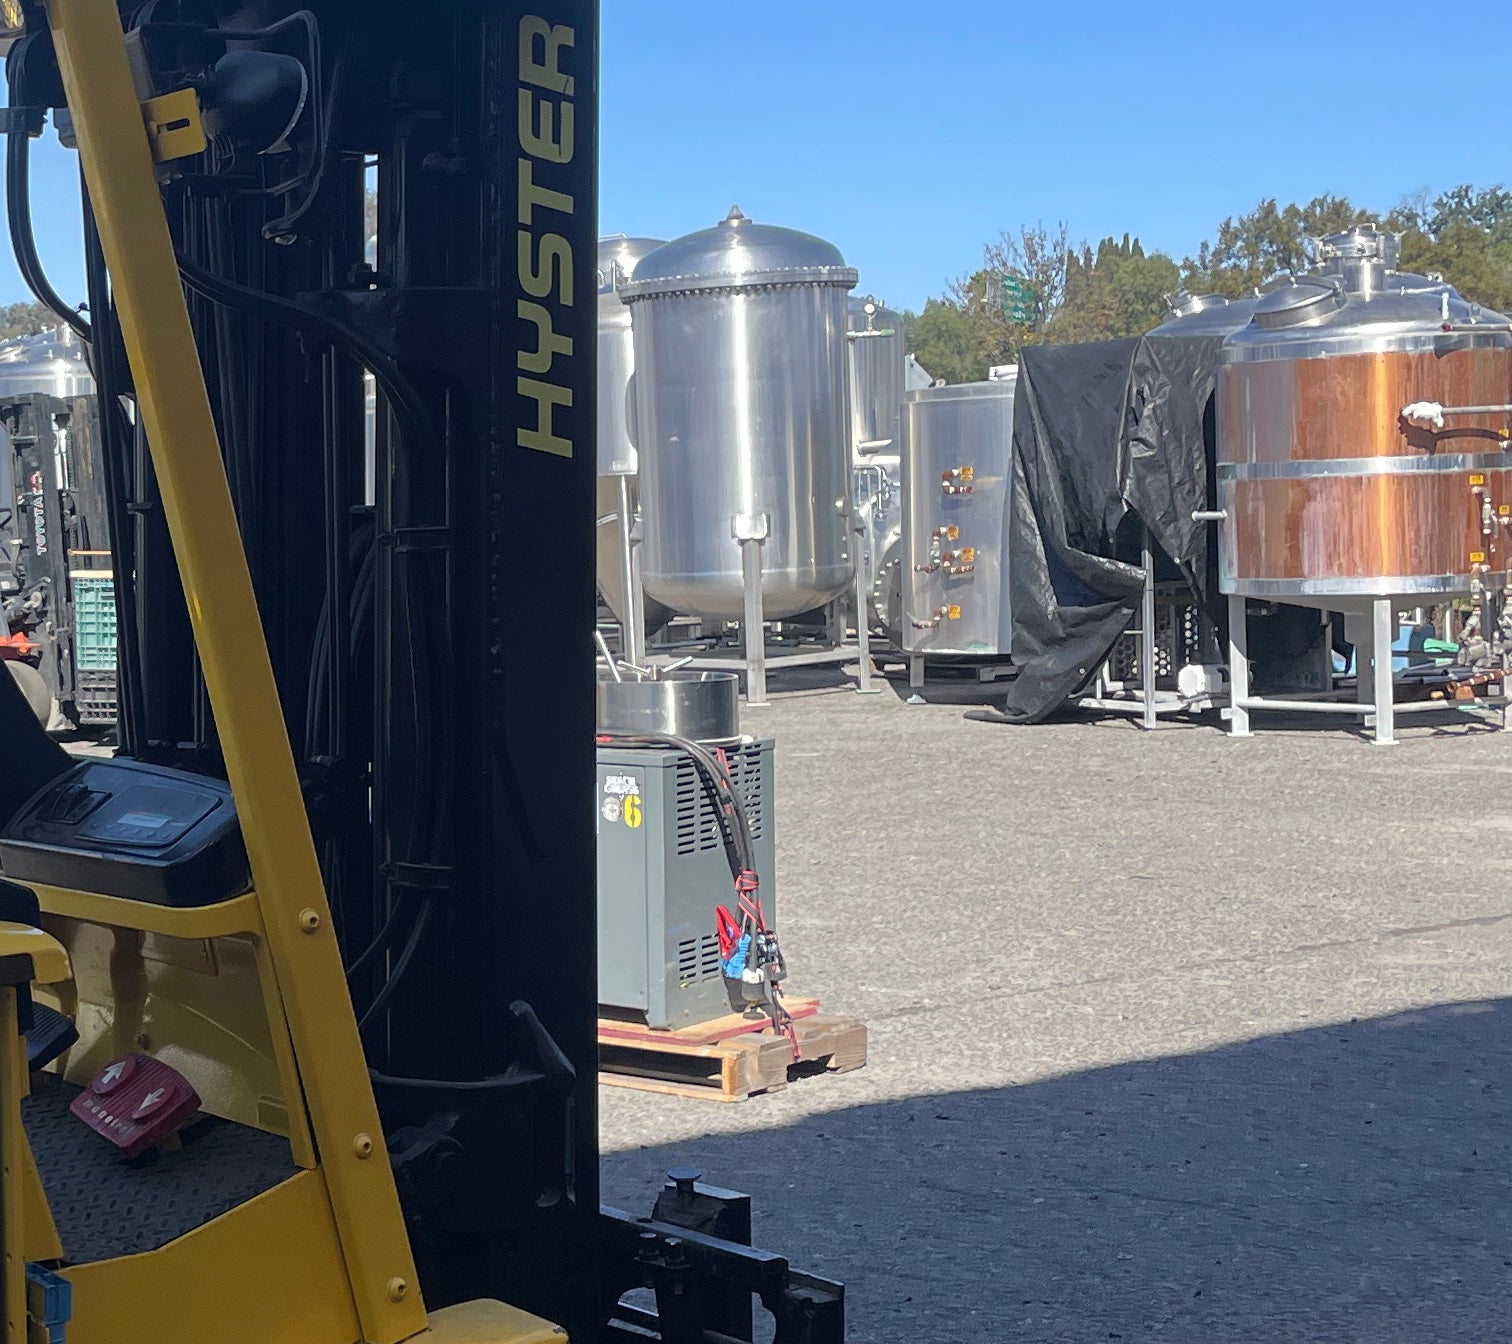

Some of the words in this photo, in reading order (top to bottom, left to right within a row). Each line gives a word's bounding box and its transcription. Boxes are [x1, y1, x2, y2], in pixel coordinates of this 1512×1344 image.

[517, 14, 575, 458] HYSTER
[33, 497, 48, 556] TOYOTA
[624, 794, 642, 828] 6
